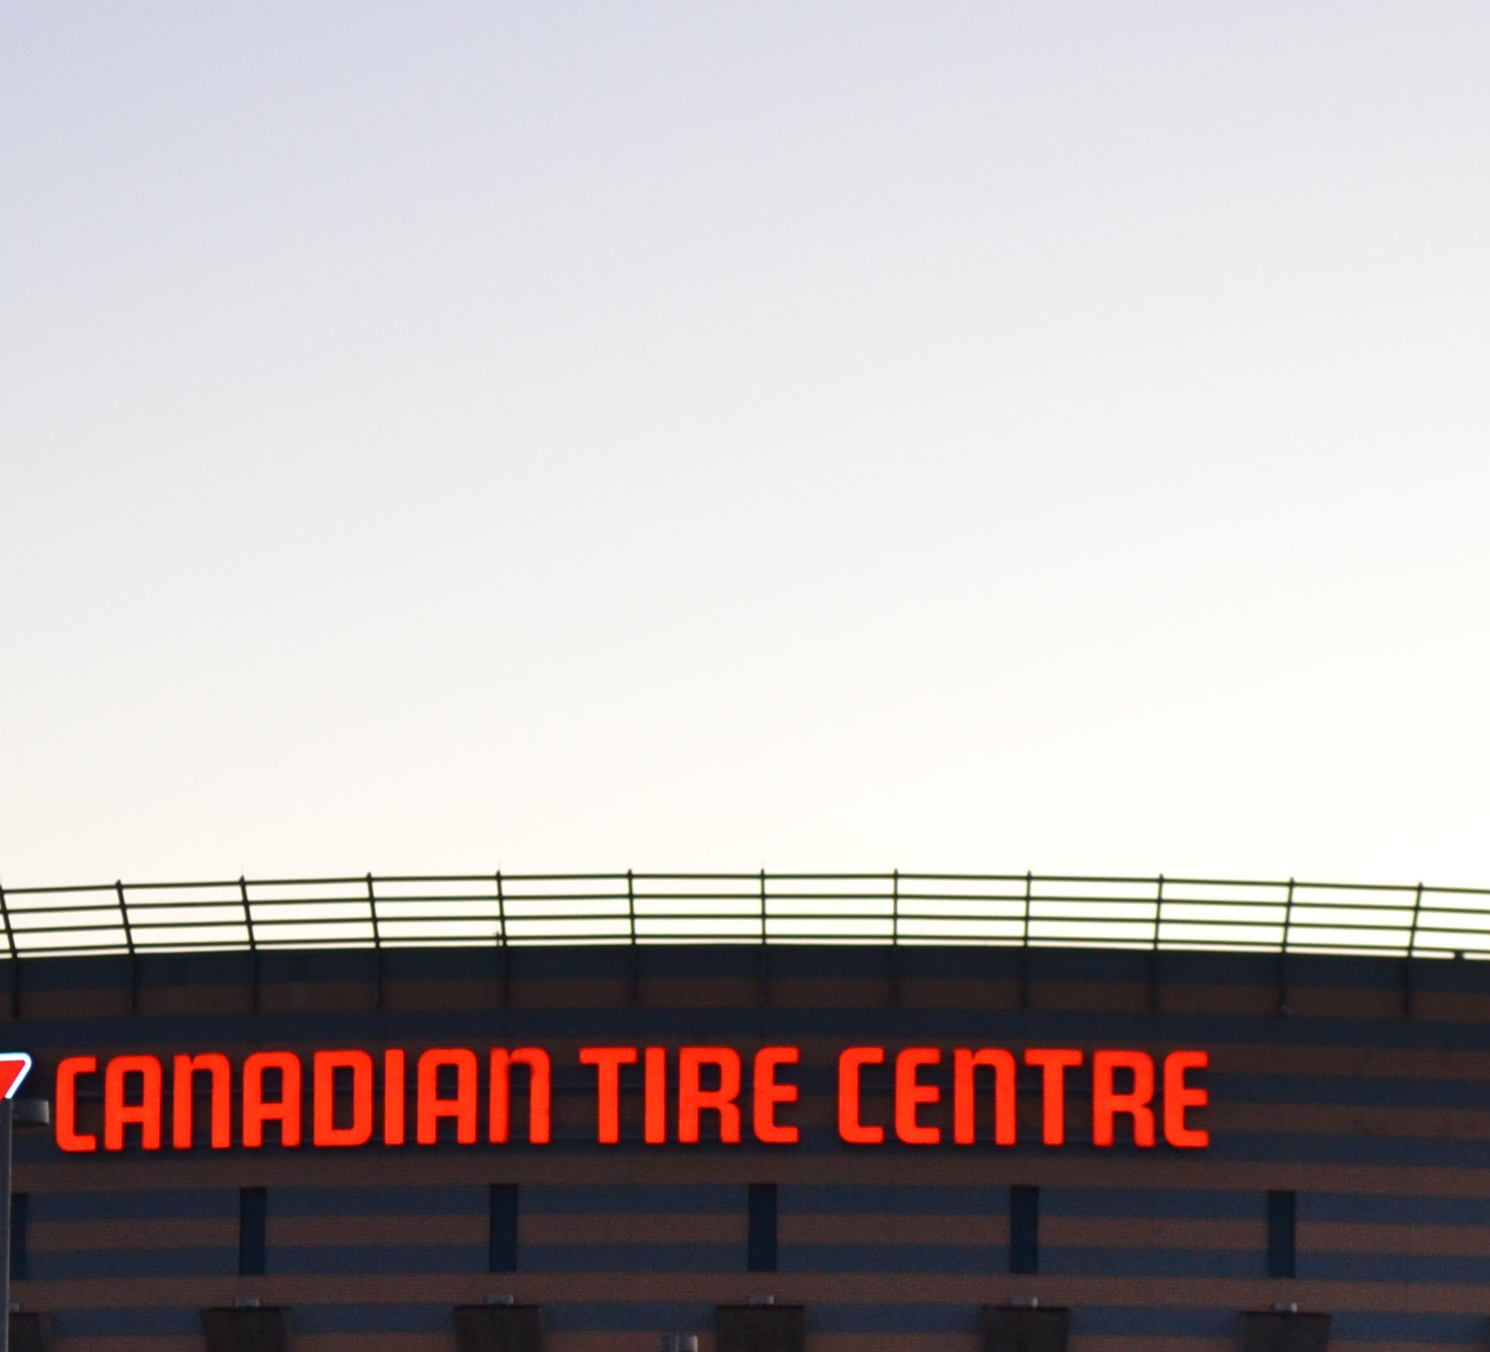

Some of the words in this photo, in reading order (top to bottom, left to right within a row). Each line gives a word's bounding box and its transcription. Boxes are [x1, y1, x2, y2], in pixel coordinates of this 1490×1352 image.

[53, 1046, 552, 1153] CANADIAN
[578, 1045, 799, 1144] TIRE
[837, 1045, 1209, 1148] CENTRE
